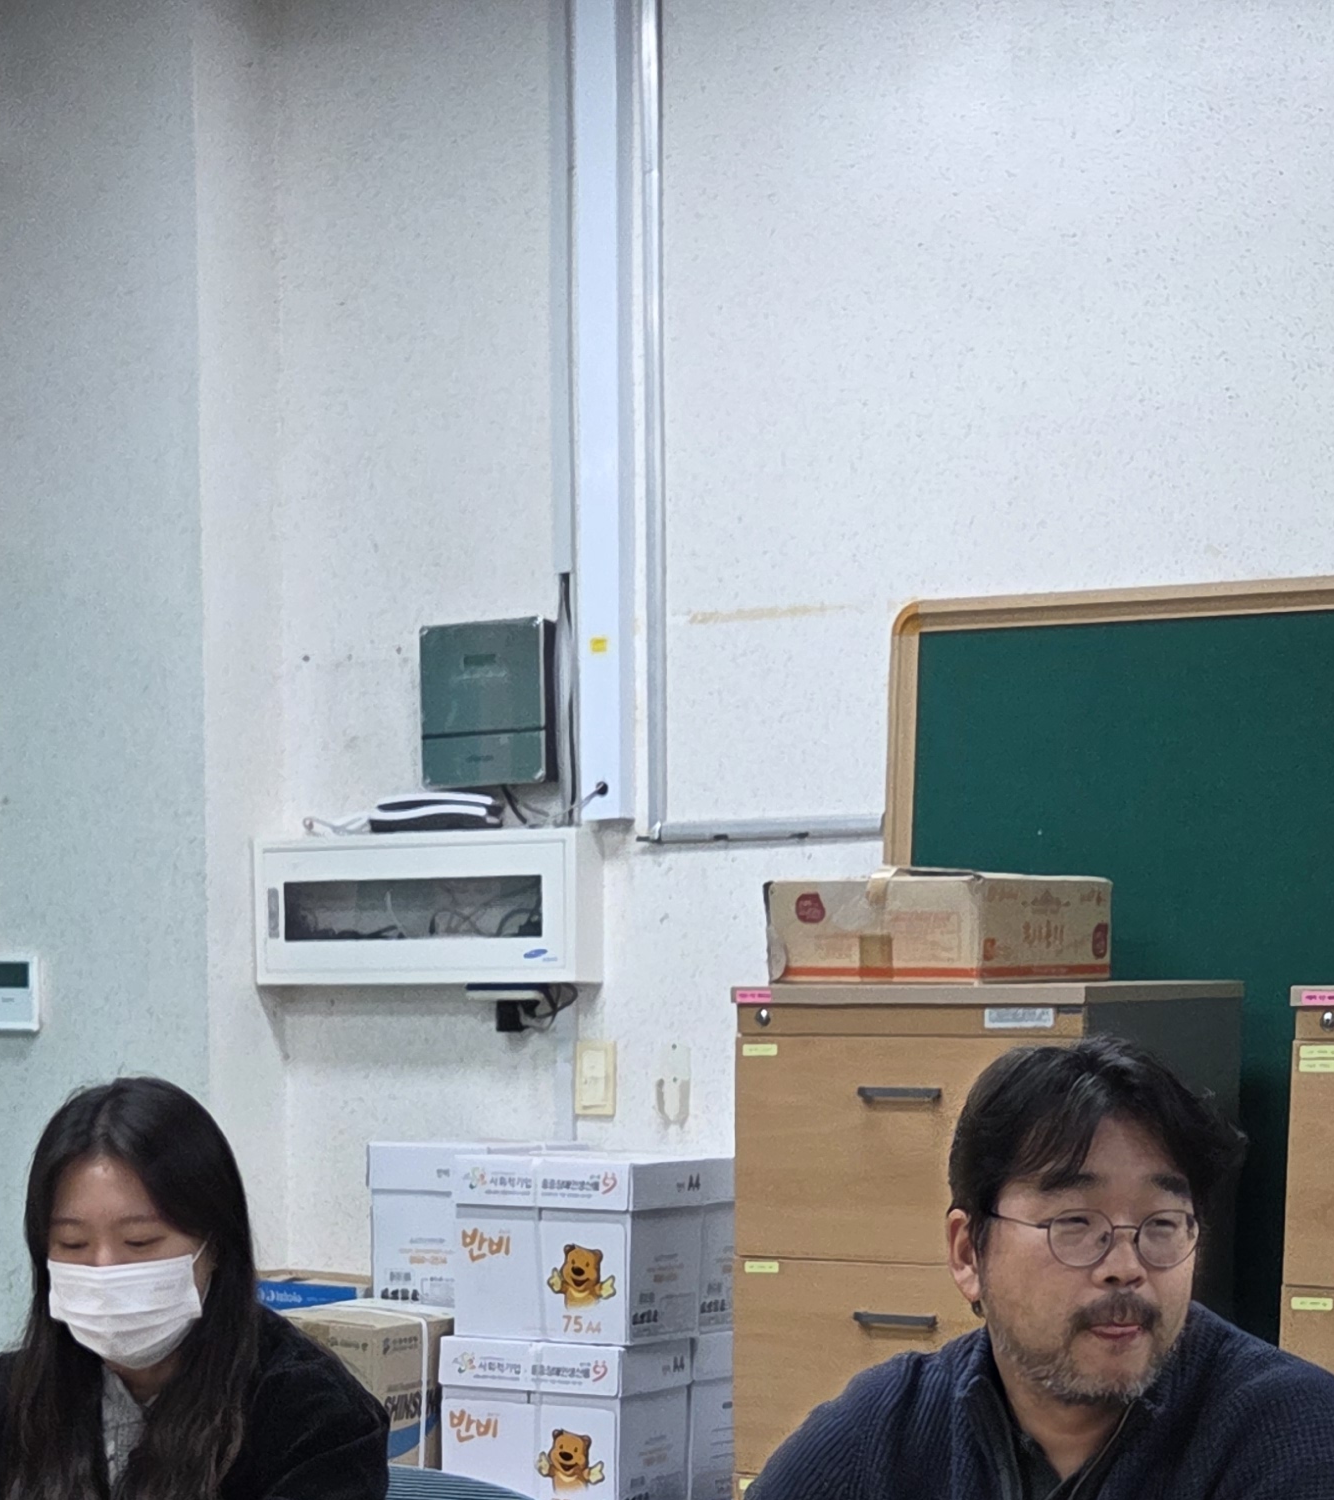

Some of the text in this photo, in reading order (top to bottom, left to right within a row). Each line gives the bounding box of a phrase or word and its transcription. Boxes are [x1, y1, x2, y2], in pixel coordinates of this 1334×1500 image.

[461, 1227, 511, 1263] 반비
[562, 1315, 602, 1334] 75 A4
[449, 1408, 499, 1443] 반비
